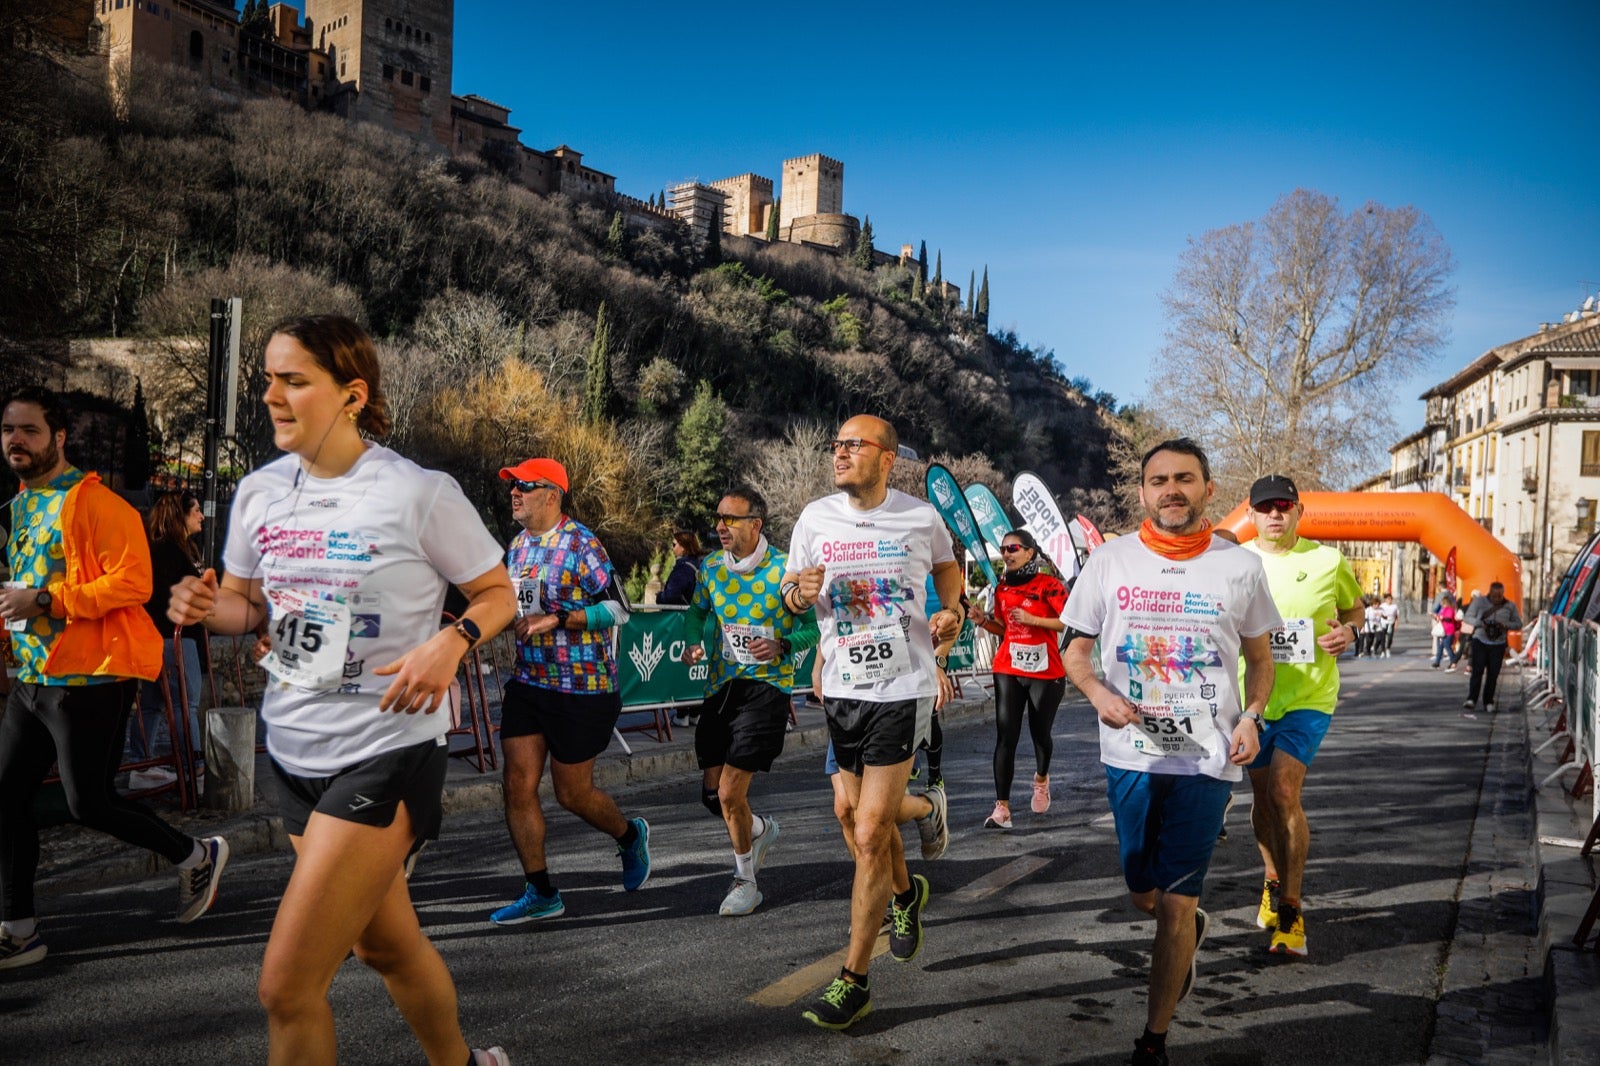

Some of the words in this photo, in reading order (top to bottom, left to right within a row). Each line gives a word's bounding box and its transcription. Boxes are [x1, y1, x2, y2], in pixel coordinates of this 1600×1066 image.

[269, 526, 324, 543] Carrera
[328, 530, 349, 540] Ave
[326, 552, 372, 563] Granada
[822, 542, 833, 563] 9
[833, 540, 874, 552] Carrera
[833, 549, 877, 563] Solidaria
[878, 551, 908, 559] Granada
[1117, 586, 1130, 611] 9
[1131, 586, 1181, 601] Carrera
[1185, 591, 1202, 599] Ave
[1130, 599, 1183, 614] Solidaria
[1184, 607, 1219, 616] Granada
[276, 612, 324, 653] 415
[849, 641, 893, 664] 528
[1016, 652, 1040, 661] 573
[1143, 716, 1193, 734] 531
